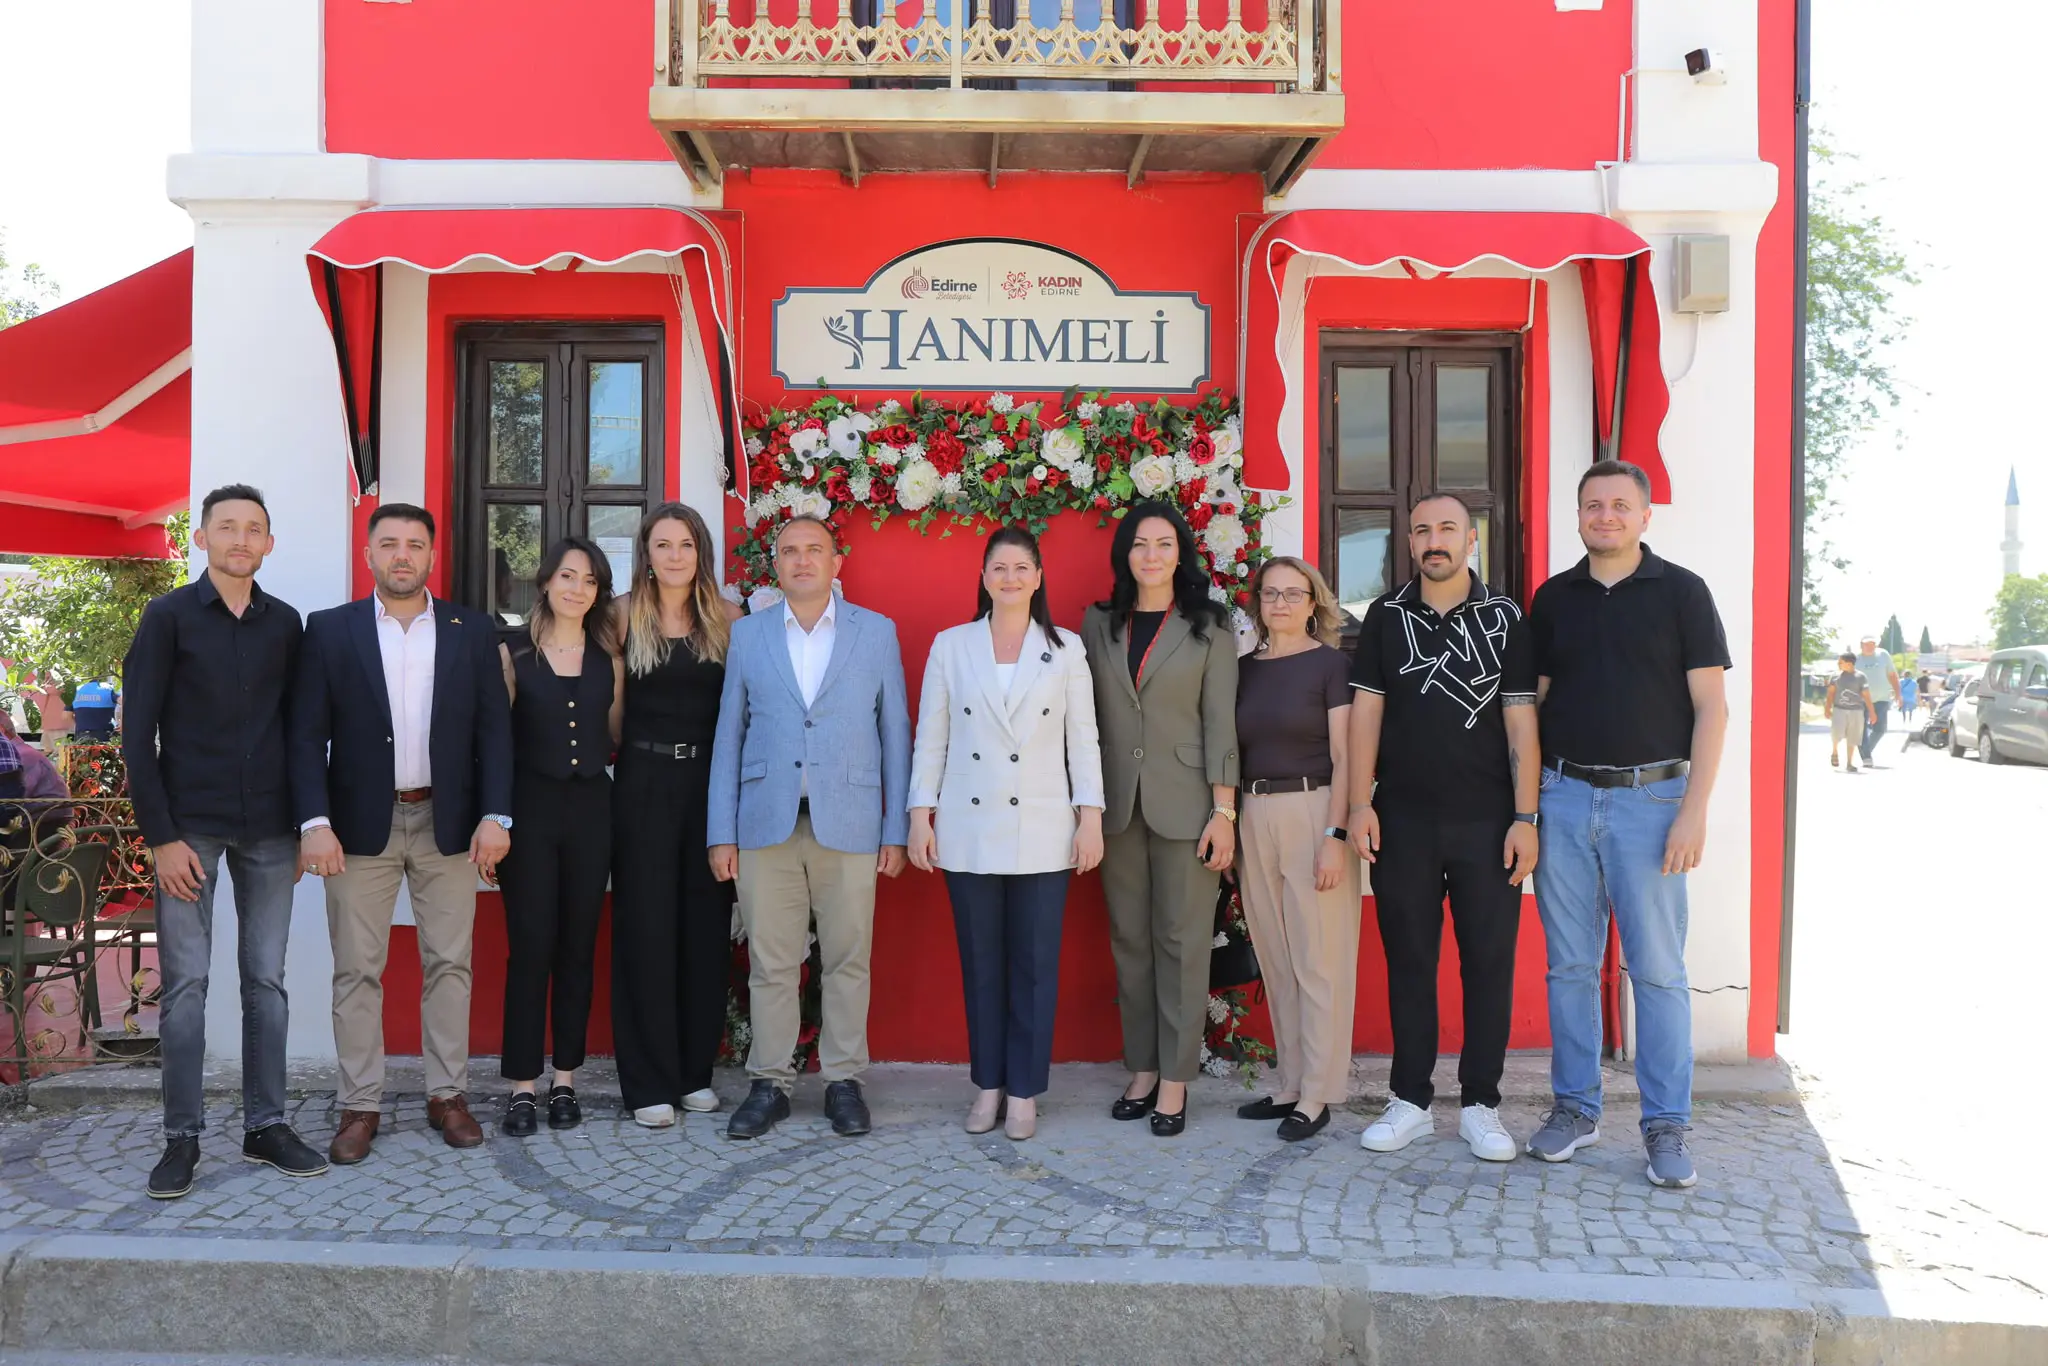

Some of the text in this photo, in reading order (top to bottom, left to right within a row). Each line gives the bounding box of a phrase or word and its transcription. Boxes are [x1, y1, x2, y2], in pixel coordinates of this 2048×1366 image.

[931, 279, 977, 292] Edirne
[1038, 277, 1083, 288] KADIN
[845, 309, 1170, 370] HANIMELİ
